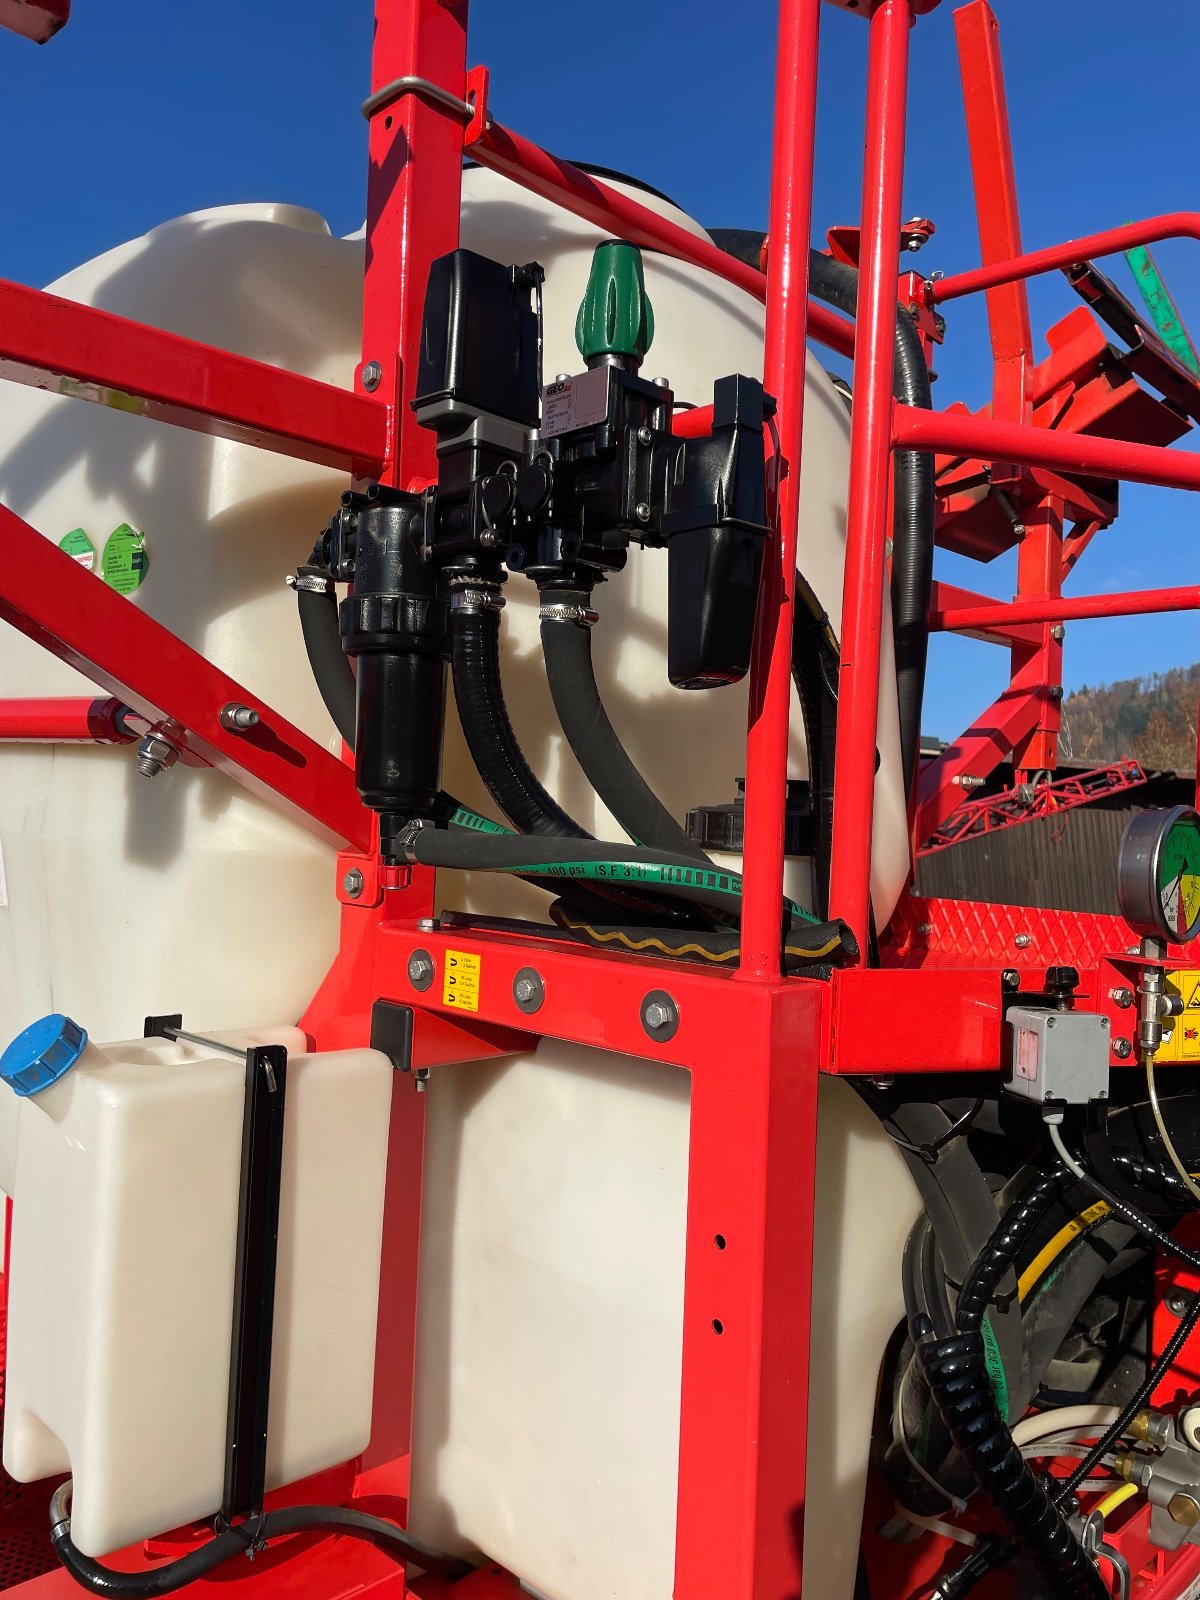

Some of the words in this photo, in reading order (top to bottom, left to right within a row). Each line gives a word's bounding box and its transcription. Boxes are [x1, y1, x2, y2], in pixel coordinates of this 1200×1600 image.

[547, 865, 566, 876] 400
[569, 864, 586, 876] psi
[989, 1348, 999, 1364] 300
[991, 1365, 1001, 1378] bar
